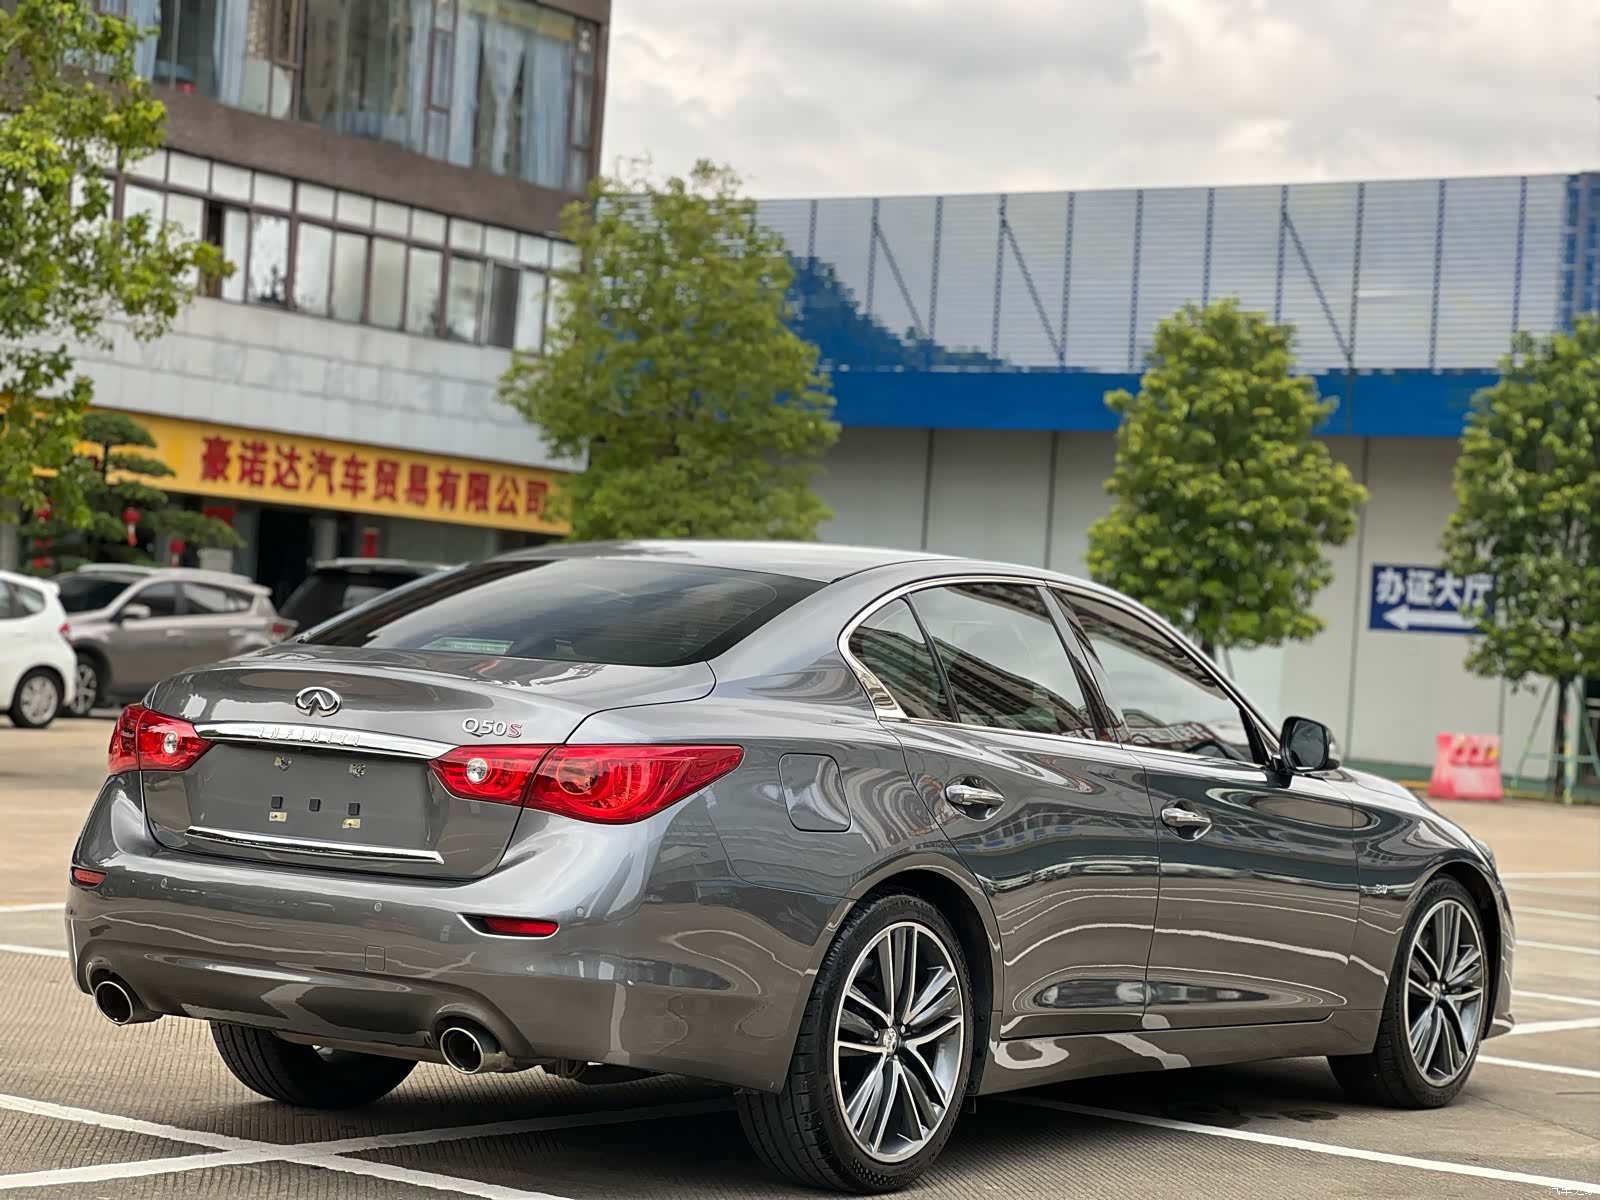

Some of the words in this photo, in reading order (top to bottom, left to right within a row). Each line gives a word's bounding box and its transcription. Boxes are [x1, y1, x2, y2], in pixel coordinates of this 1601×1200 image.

[1375, 567, 1493, 607] 办证大厅
[259, 726, 361, 746] INFINITI
[462, 718, 522, 738] Q50S
